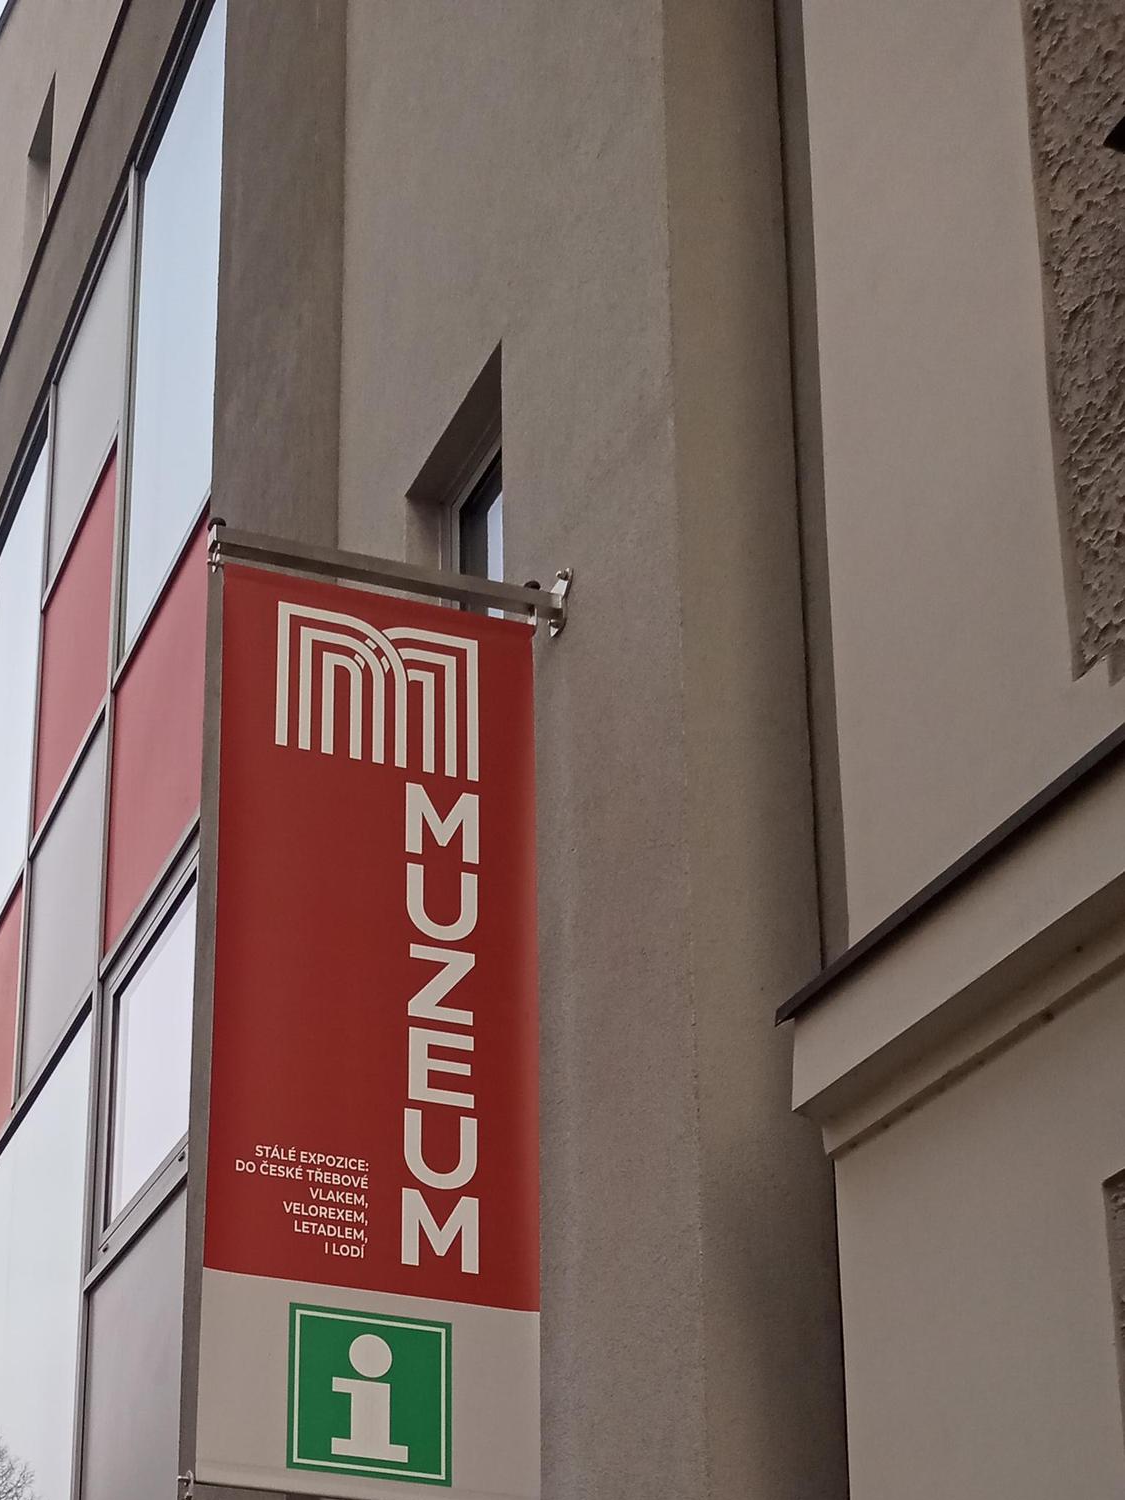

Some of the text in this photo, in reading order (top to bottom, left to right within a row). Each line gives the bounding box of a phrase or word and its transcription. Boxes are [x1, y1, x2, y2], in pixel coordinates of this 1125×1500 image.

[400, 782, 479, 1275] MUZEUM
[255, 1144, 369, 1172] STÁLÉ EXPOZICE:
[235, 1159, 369, 1189] DO ČESKÉ TŘEBOVÉ
[309, 1187, 369, 1209] VLAKEM,
[283, 1200, 369, 1226] VELOREXEM,
[294, 1220, 368, 1244] LETADLEM,
[324, 1241, 365, 1259] I LODÍ
